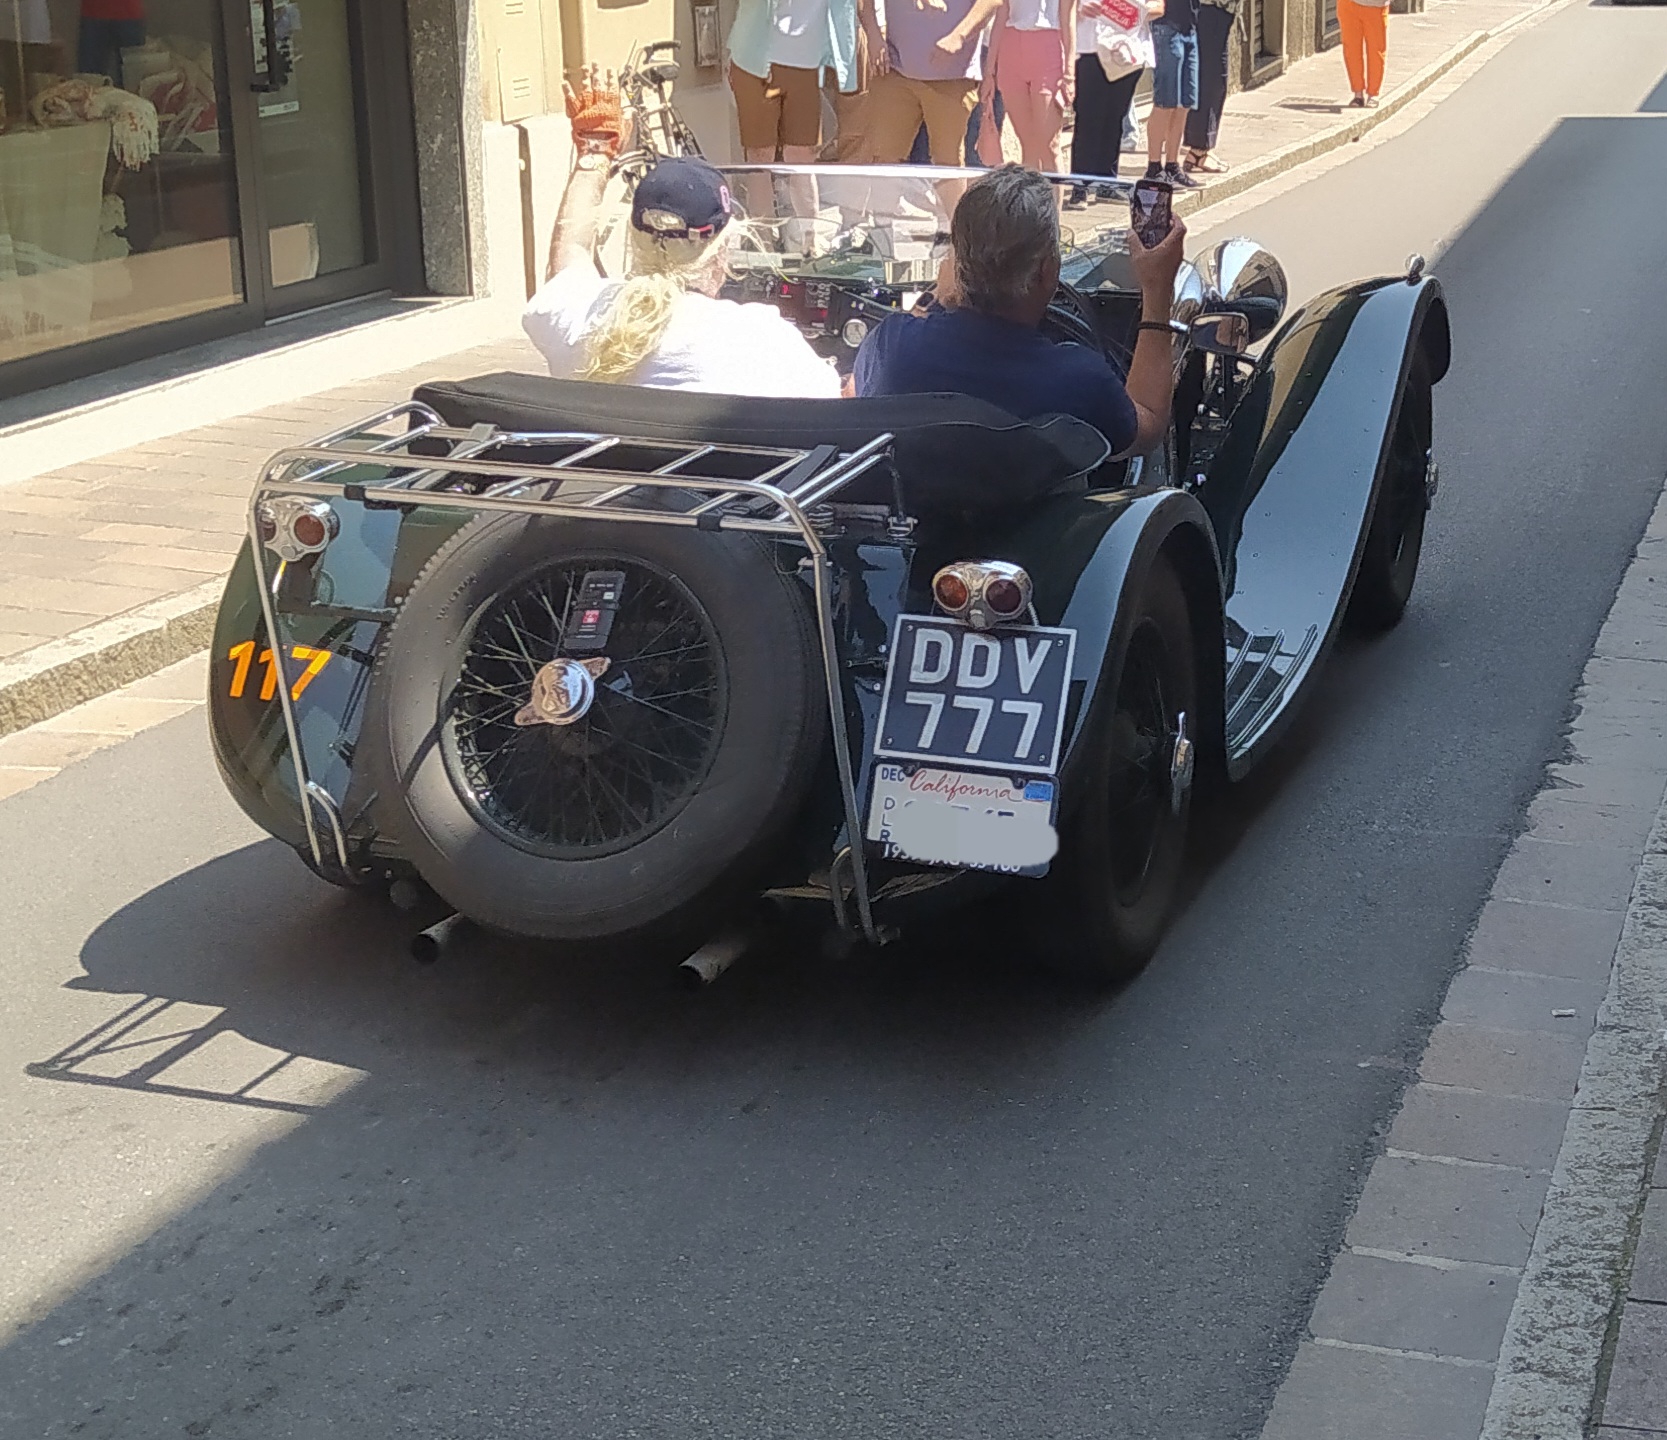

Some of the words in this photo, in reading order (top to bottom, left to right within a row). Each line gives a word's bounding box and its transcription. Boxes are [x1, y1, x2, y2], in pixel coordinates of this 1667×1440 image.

[228, 640, 332, 701] 117
[909, 628, 1052, 694] DDV
[905, 691, 1043, 758] 777
[881, 766, 905, 782] DEC
[909, 769, 1020, 802] California
